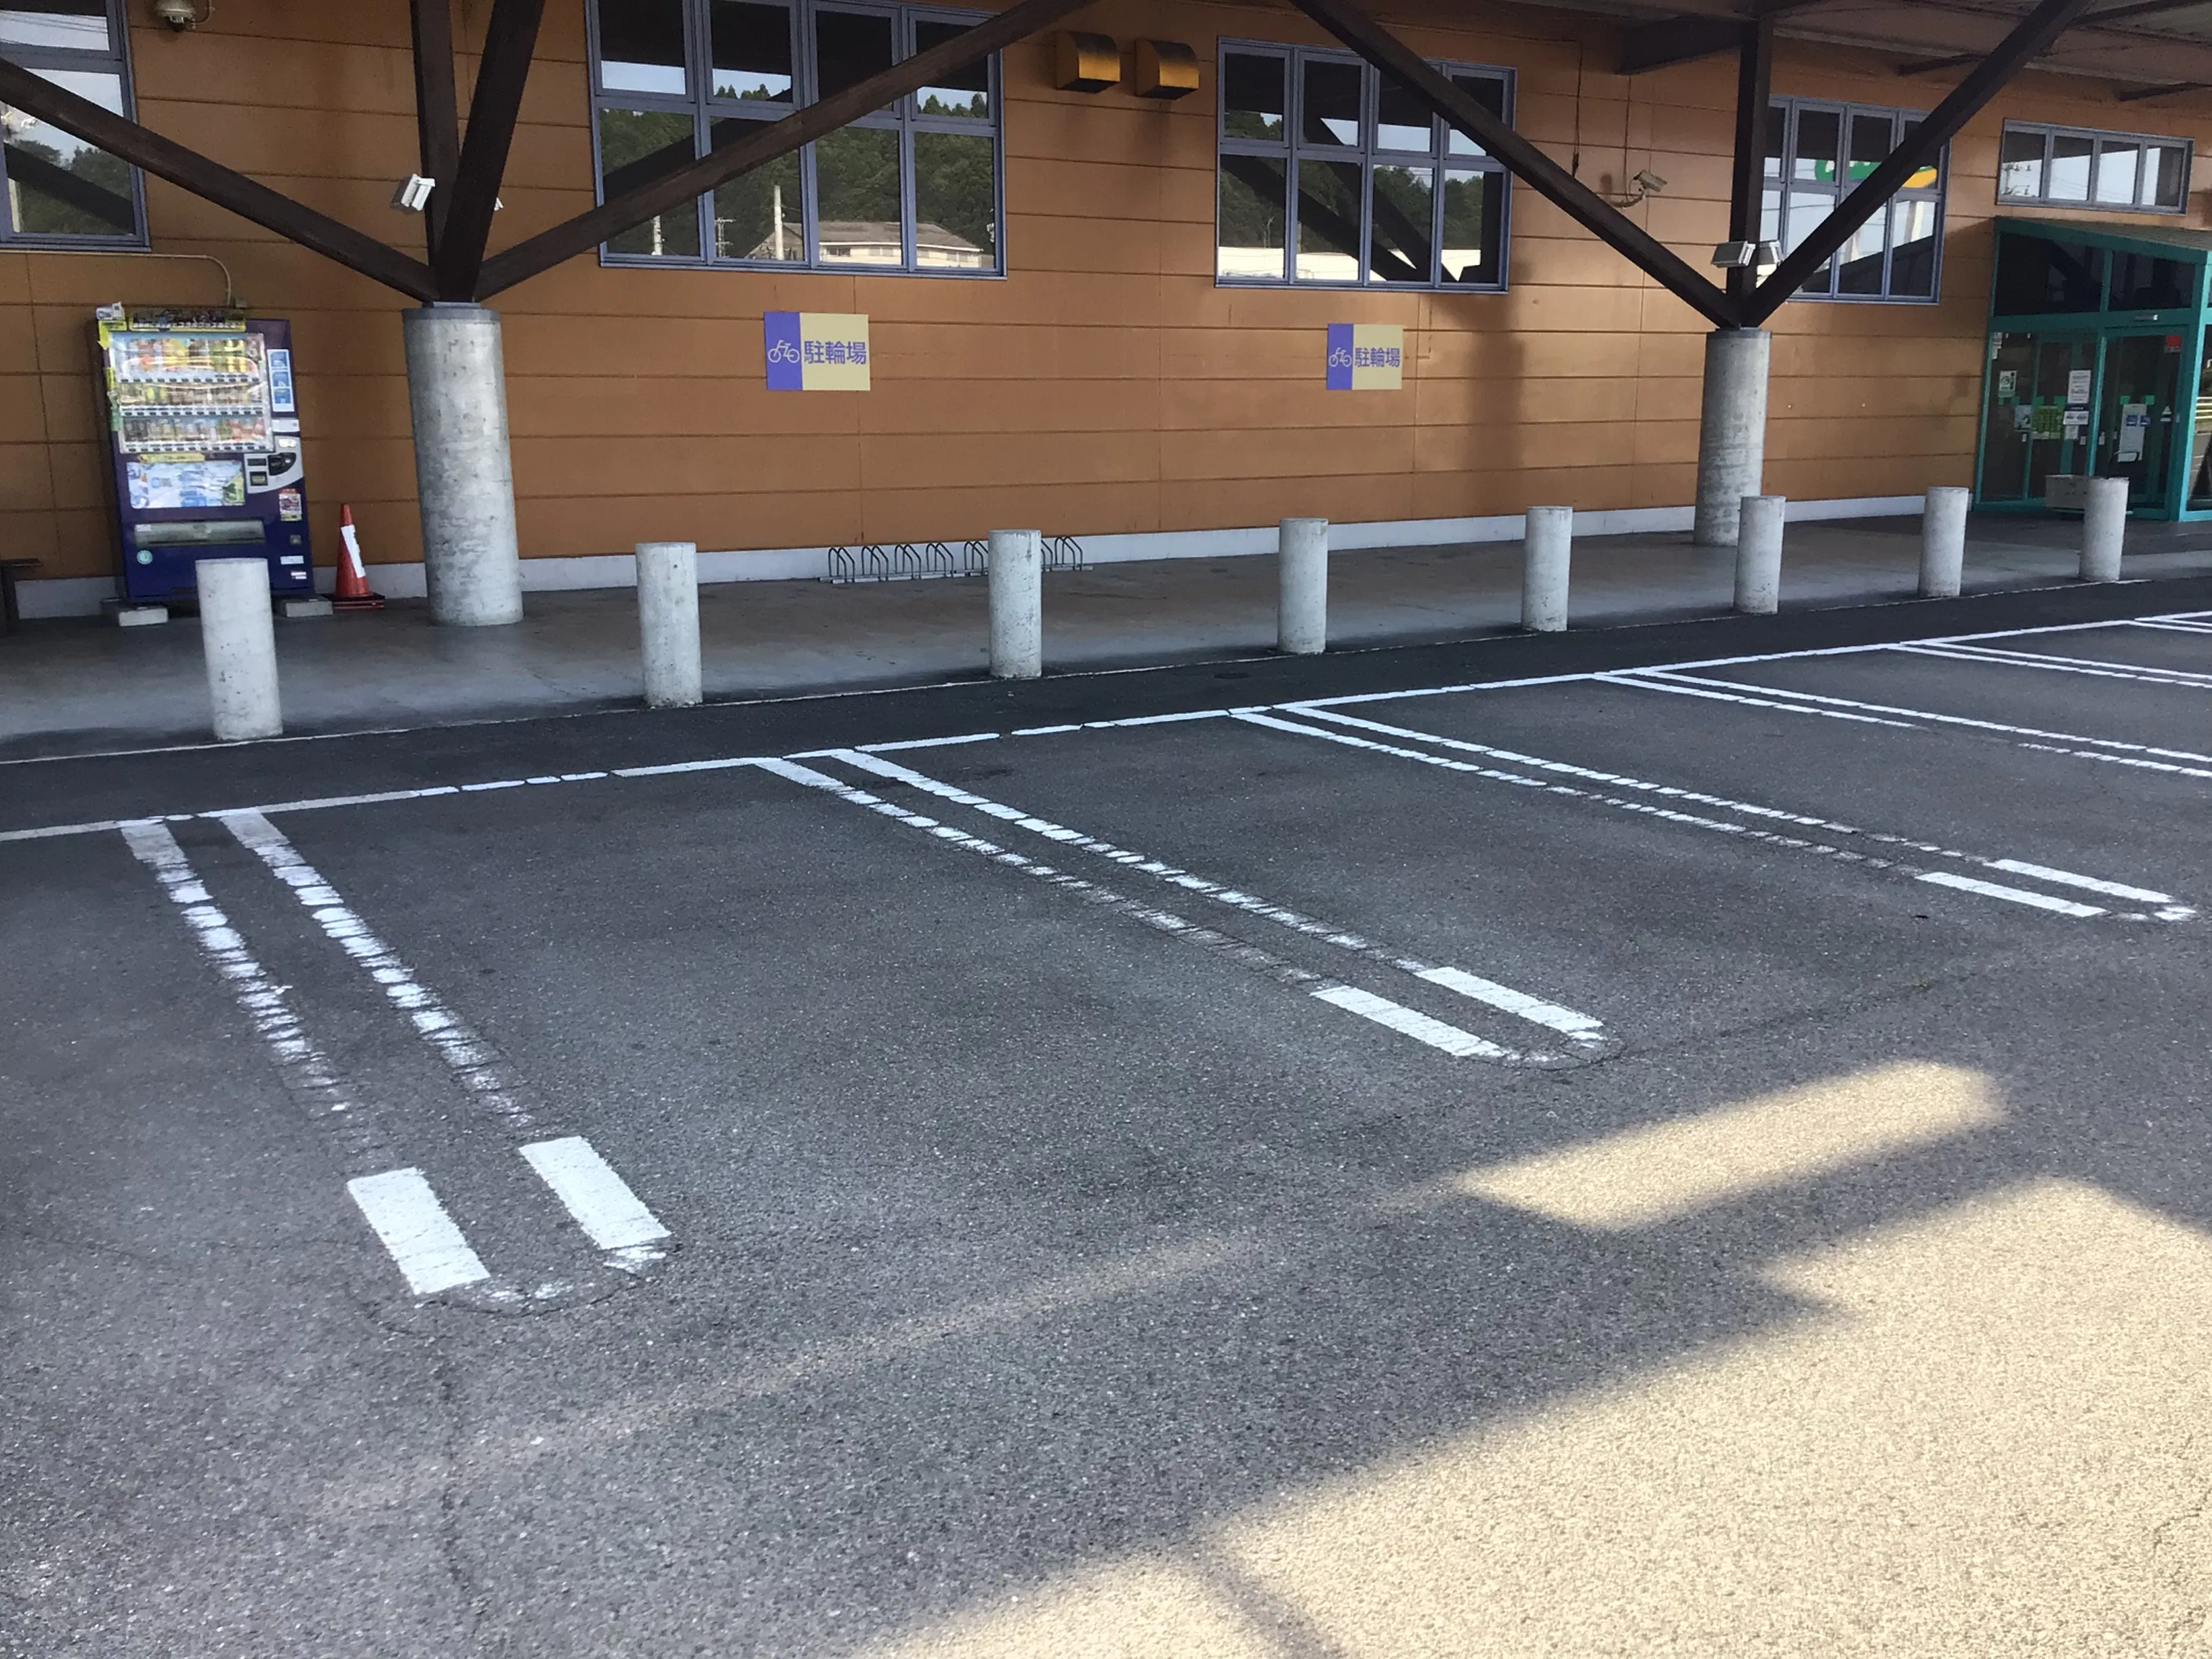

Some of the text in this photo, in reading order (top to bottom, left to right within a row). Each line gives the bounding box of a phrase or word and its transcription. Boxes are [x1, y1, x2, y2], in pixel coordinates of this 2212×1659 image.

[804, 341, 867, 365] 駐輪場
[1355, 348, 1401, 367] 駐輪場
